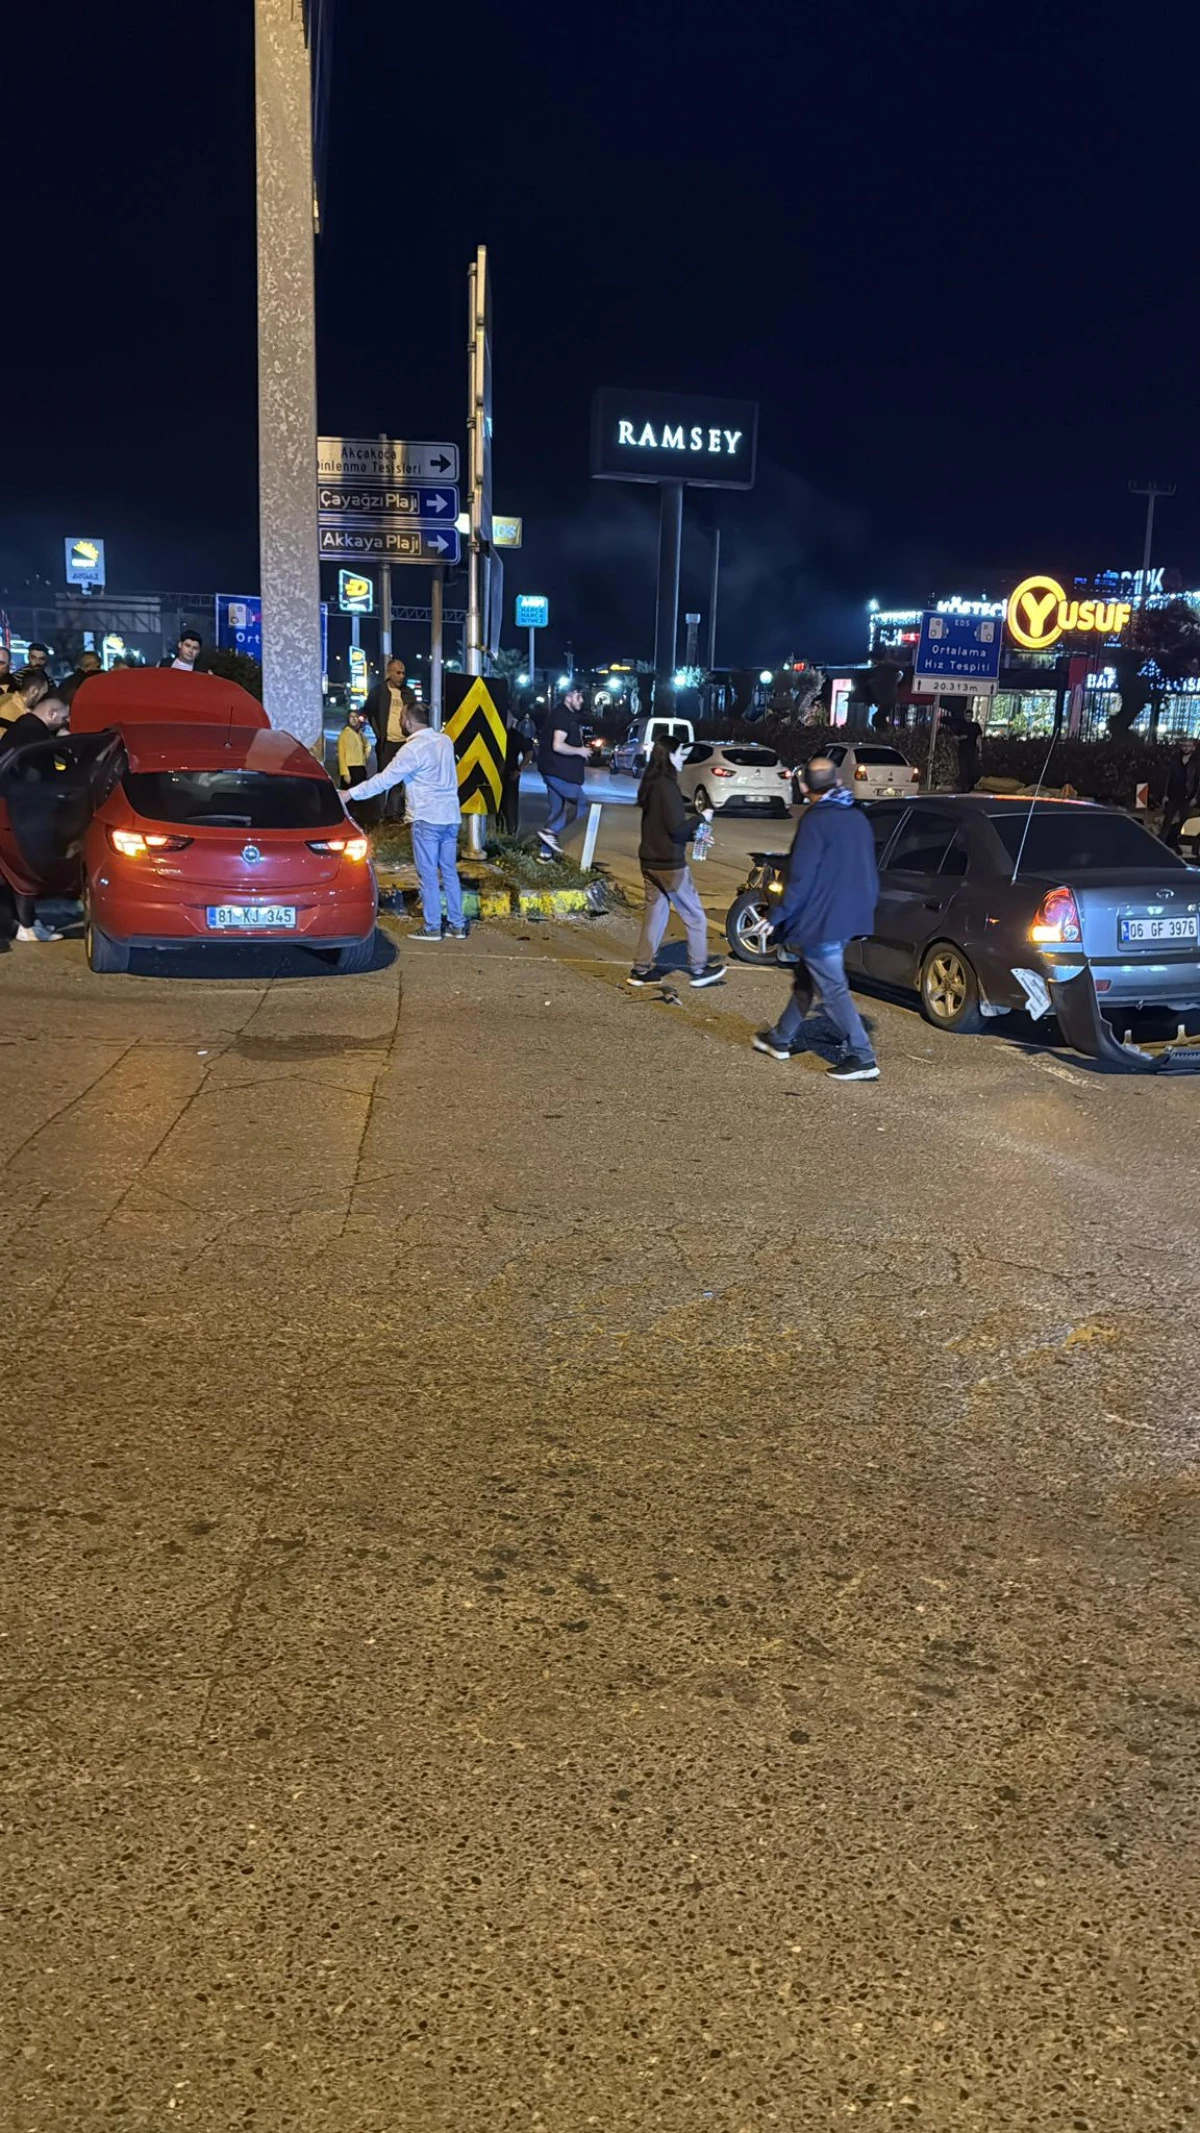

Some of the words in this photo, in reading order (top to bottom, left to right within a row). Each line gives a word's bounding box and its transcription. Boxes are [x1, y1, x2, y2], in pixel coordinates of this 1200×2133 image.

[618, 420, 742, 454] RAMSEY
[341, 447, 397, 460] Akçakoca
[372, 461, 421, 474] Tesisleri
[320, 490, 384, 510] Çayağzı
[385, 493, 417, 512] Plajı
[323, 532, 383, 551] Akkaya
[386, 535, 419, 553] Plajı
[1018, 590, 1131, 638] YUSUF
[931, 644, 987, 657] Ortalama
[924, 658, 945, 670] Hız
[950, 660, 991, 673] Tespiti
[933, 682, 978, 692] 20.313m
[218, 909, 232, 923] 81
[243, 909, 259, 923] KJ
[267, 909, 292, 923] 345
[1130, 923, 1144, 938] 06
[1151, 922, 1164, 937] GF
[1169, 920, 1195, 936] 3976
